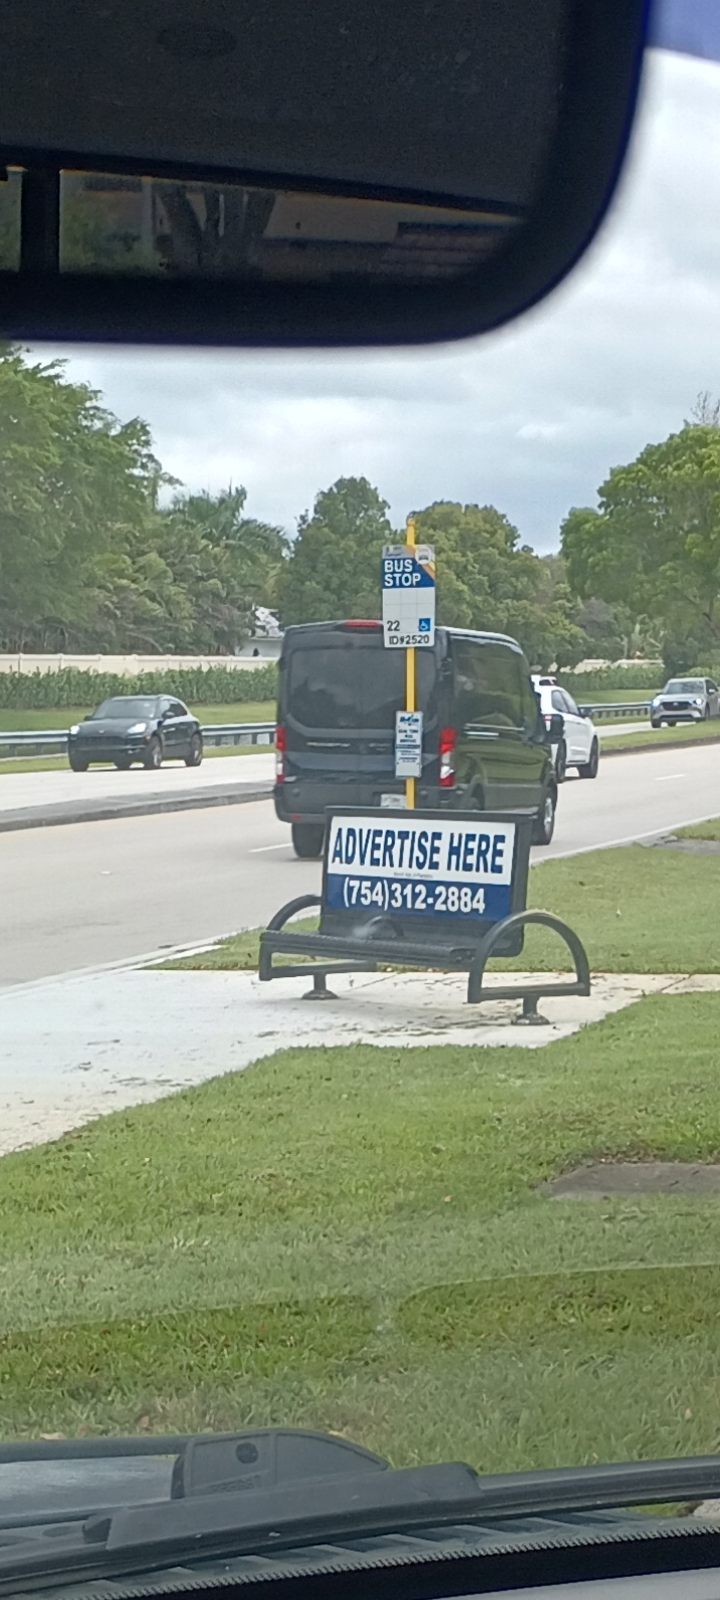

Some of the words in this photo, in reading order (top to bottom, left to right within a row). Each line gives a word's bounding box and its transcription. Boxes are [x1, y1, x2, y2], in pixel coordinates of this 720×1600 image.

[384, 559, 413, 573] BUS
[384, 573, 421, 587] STOP
[386, 620, 400, 632] 22
[331, 827, 443, 871] ADVERTISE
[446, 832, 506, 874] HERE
[343, 876, 485, 914] (754)312-2884
